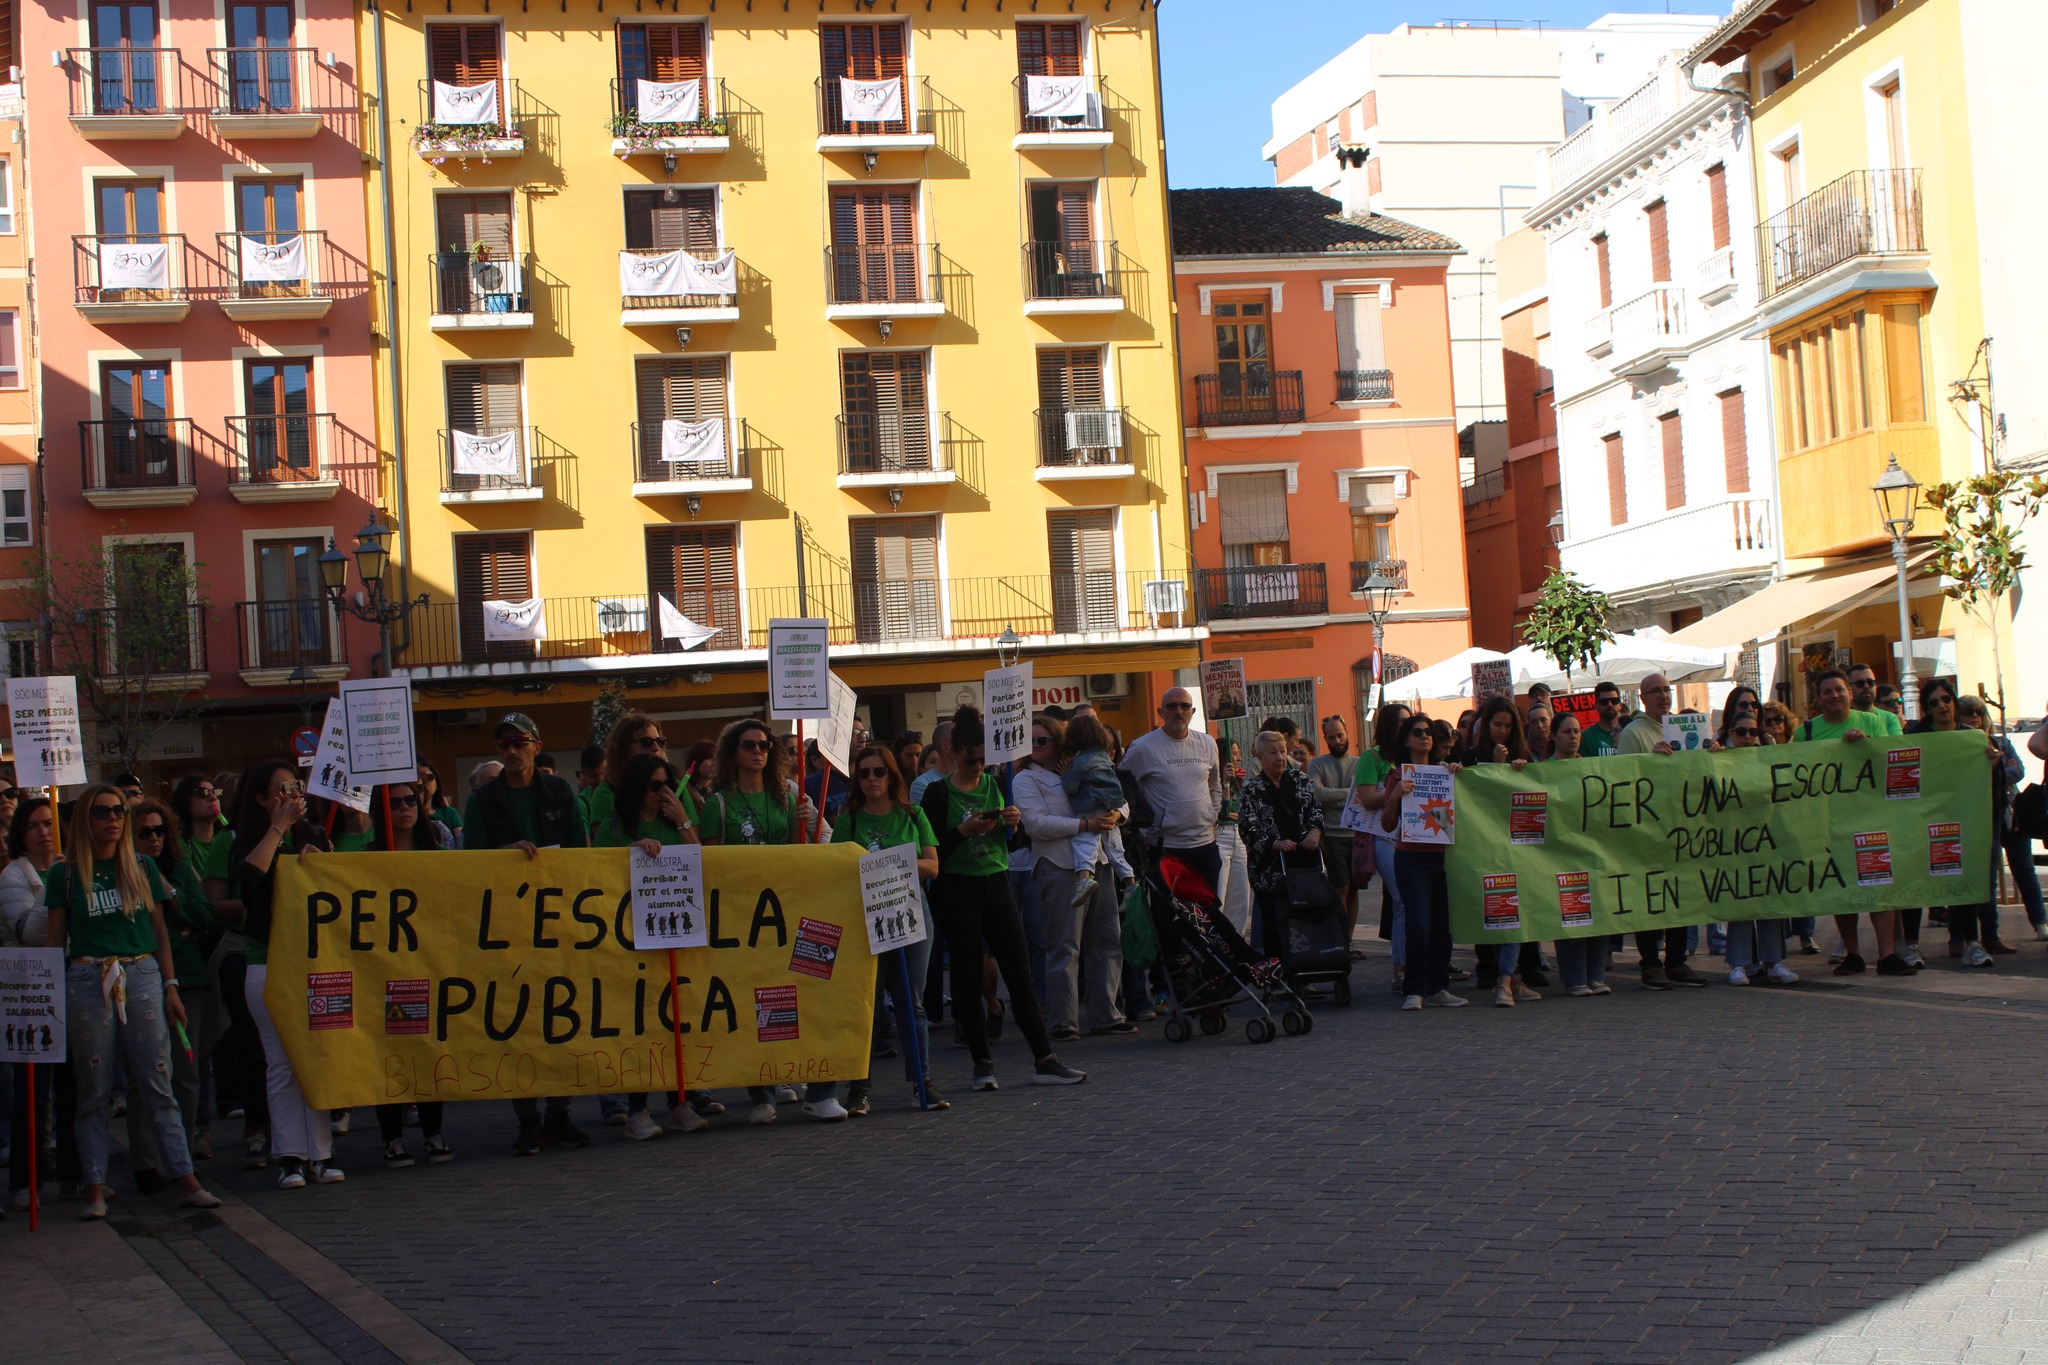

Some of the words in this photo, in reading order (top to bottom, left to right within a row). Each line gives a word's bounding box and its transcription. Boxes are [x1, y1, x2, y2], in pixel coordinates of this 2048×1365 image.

[1484, 661, 1507, 670] PREMI
[1205, 671, 1241, 683] MENTIDA
[1474, 671, 1505, 684] FALTA
[1207, 678, 1242, 693] INCLUSIÓ
[992, 693, 1015, 703] Parlar
[1017, 690, 1024, 698] en
[1032, 686, 1080, 705] non
[991, 699, 1024, 714] VALENCIÀ
[1553, 697, 1570, 712] SE
[1569, 693, 1596, 710] VEN
[15, 709, 34, 718] SER
[38, 707, 74, 717] MESTRA
[385, 711, 400, 721] PER
[1000, 714, 1023, 725] l'escola
[1668, 716, 1688, 724] ANEM
[1888, 752, 1898, 761] 11
[1513, 794, 1524, 804] 11
[1581, 774, 1660, 832] PER
[1682, 775, 1743, 817] UNA
[1770, 758, 1876, 802] ESCOLA
[1930, 826, 1938, 836] 11
[1667, 822, 1777, 862] PÚBLICA
[1855, 835, 1866, 845] 11
[636, 857, 650, 868] SÓC
[652, 856, 682, 867] MESTRA
[861, 860, 874, 873] SÓC
[875, 853, 902, 869] MESTRA
[642, 874, 678, 884] Arribar
[865, 875, 898, 890] Recursos
[899, 871, 912, 881] per
[1484, 877, 1494, 887] 11
[1558, 875, 1567, 885] 11
[1608, 873, 1633, 914] I
[1644, 869, 1679, 914] EN
[1700, 846, 1846, 903] VALENCIÀ
[637, 888, 656, 896] TOT
[661, 887, 670, 895] el
[878, 883, 910, 898] l'alumnat
[647, 899, 685, 909] alumnat
[866, 895, 907, 913] NOUVINGUT
[307, 888, 418, 958] PER
[478, 881, 787, 950] L'ESCLA
[802, 918, 809, 928] 7
[13, 959, 44, 971] MESTRA
[310, 975, 317, 984] 7
[46, 982, 55, 990] el
[388, 981, 394, 990] 7
[20, 995, 51, 1003] PODER
[756, 990, 762, 999] 7
[6, 1007, 47, 1016] SALARIAL
[384, 1052, 536, 1098] BLASCO
[759, 1057, 834, 1082] ALZIRA
